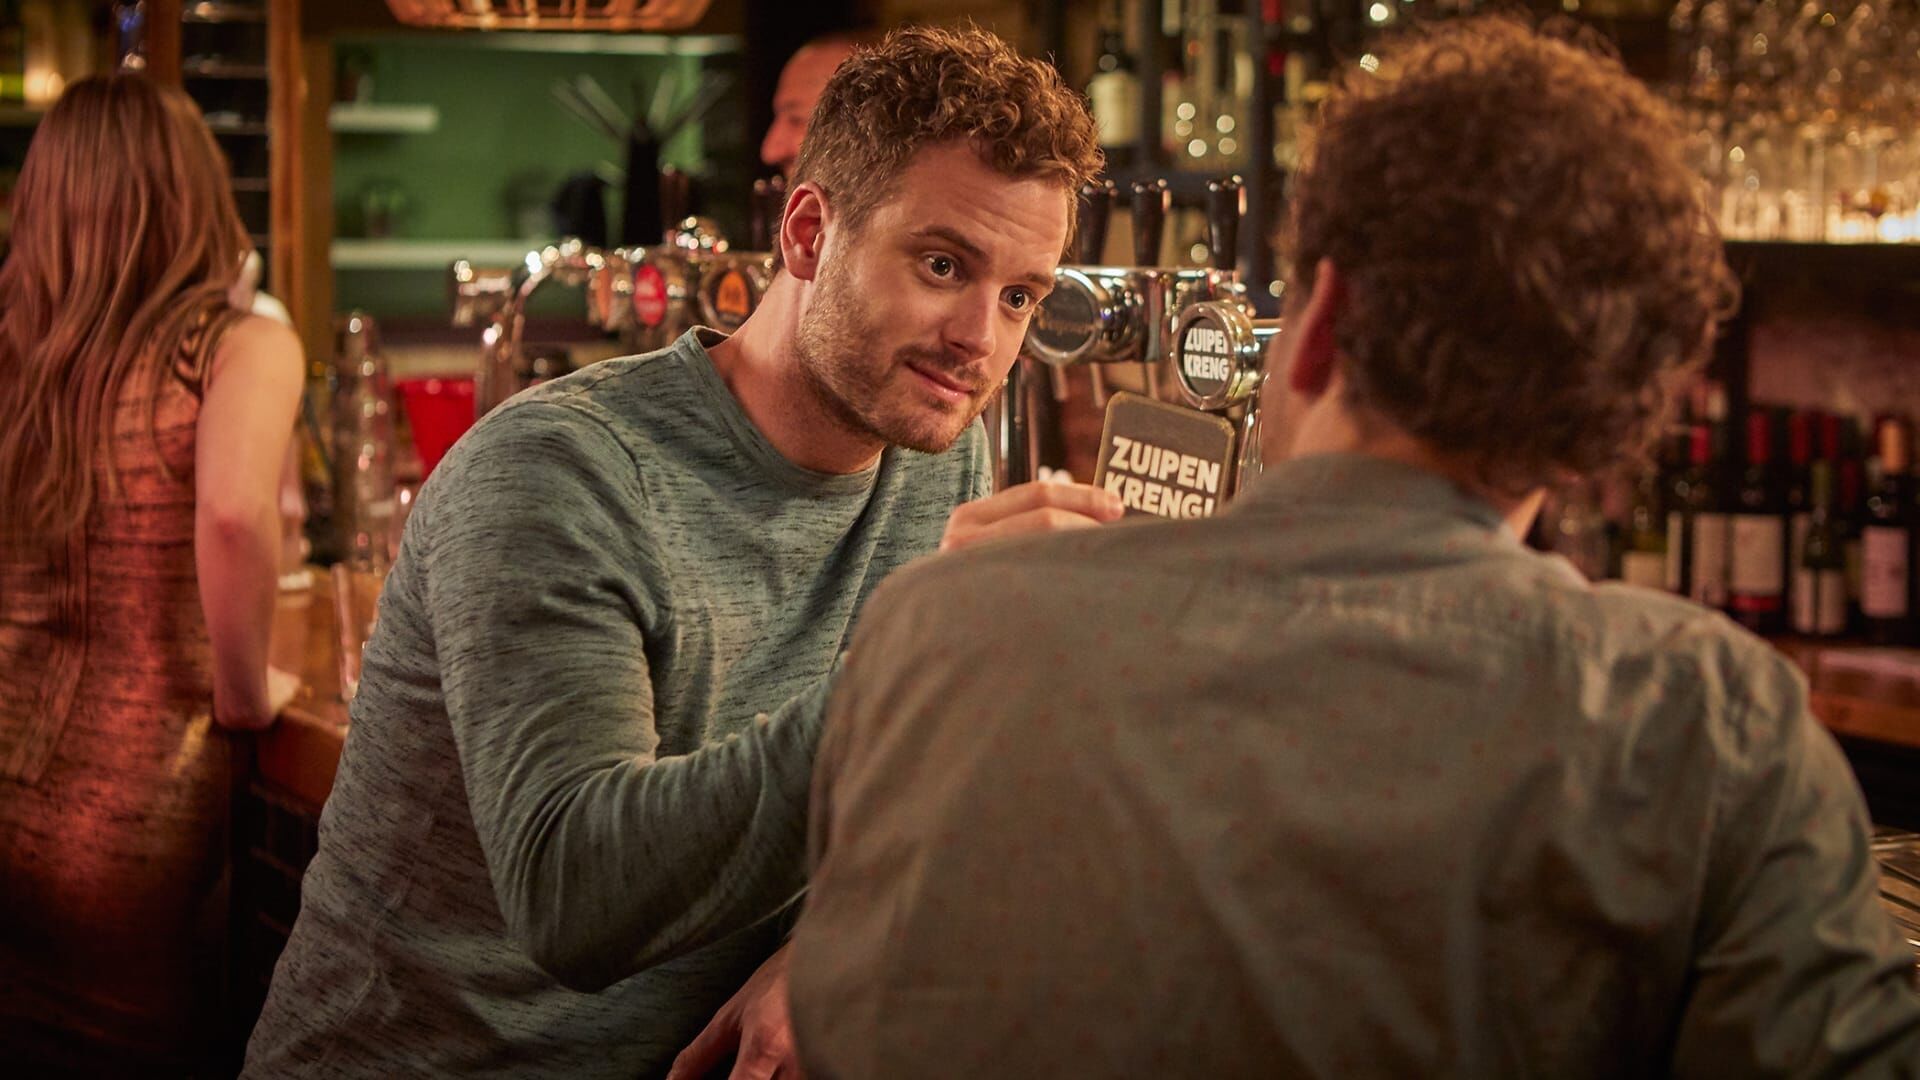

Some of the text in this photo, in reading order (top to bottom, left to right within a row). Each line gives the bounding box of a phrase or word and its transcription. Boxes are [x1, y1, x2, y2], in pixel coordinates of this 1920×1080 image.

[1183, 353, 1230, 381] KRENG
[1109, 435, 1220, 494] ZUIPEN
[1104, 471, 1215, 520] KRENG!
